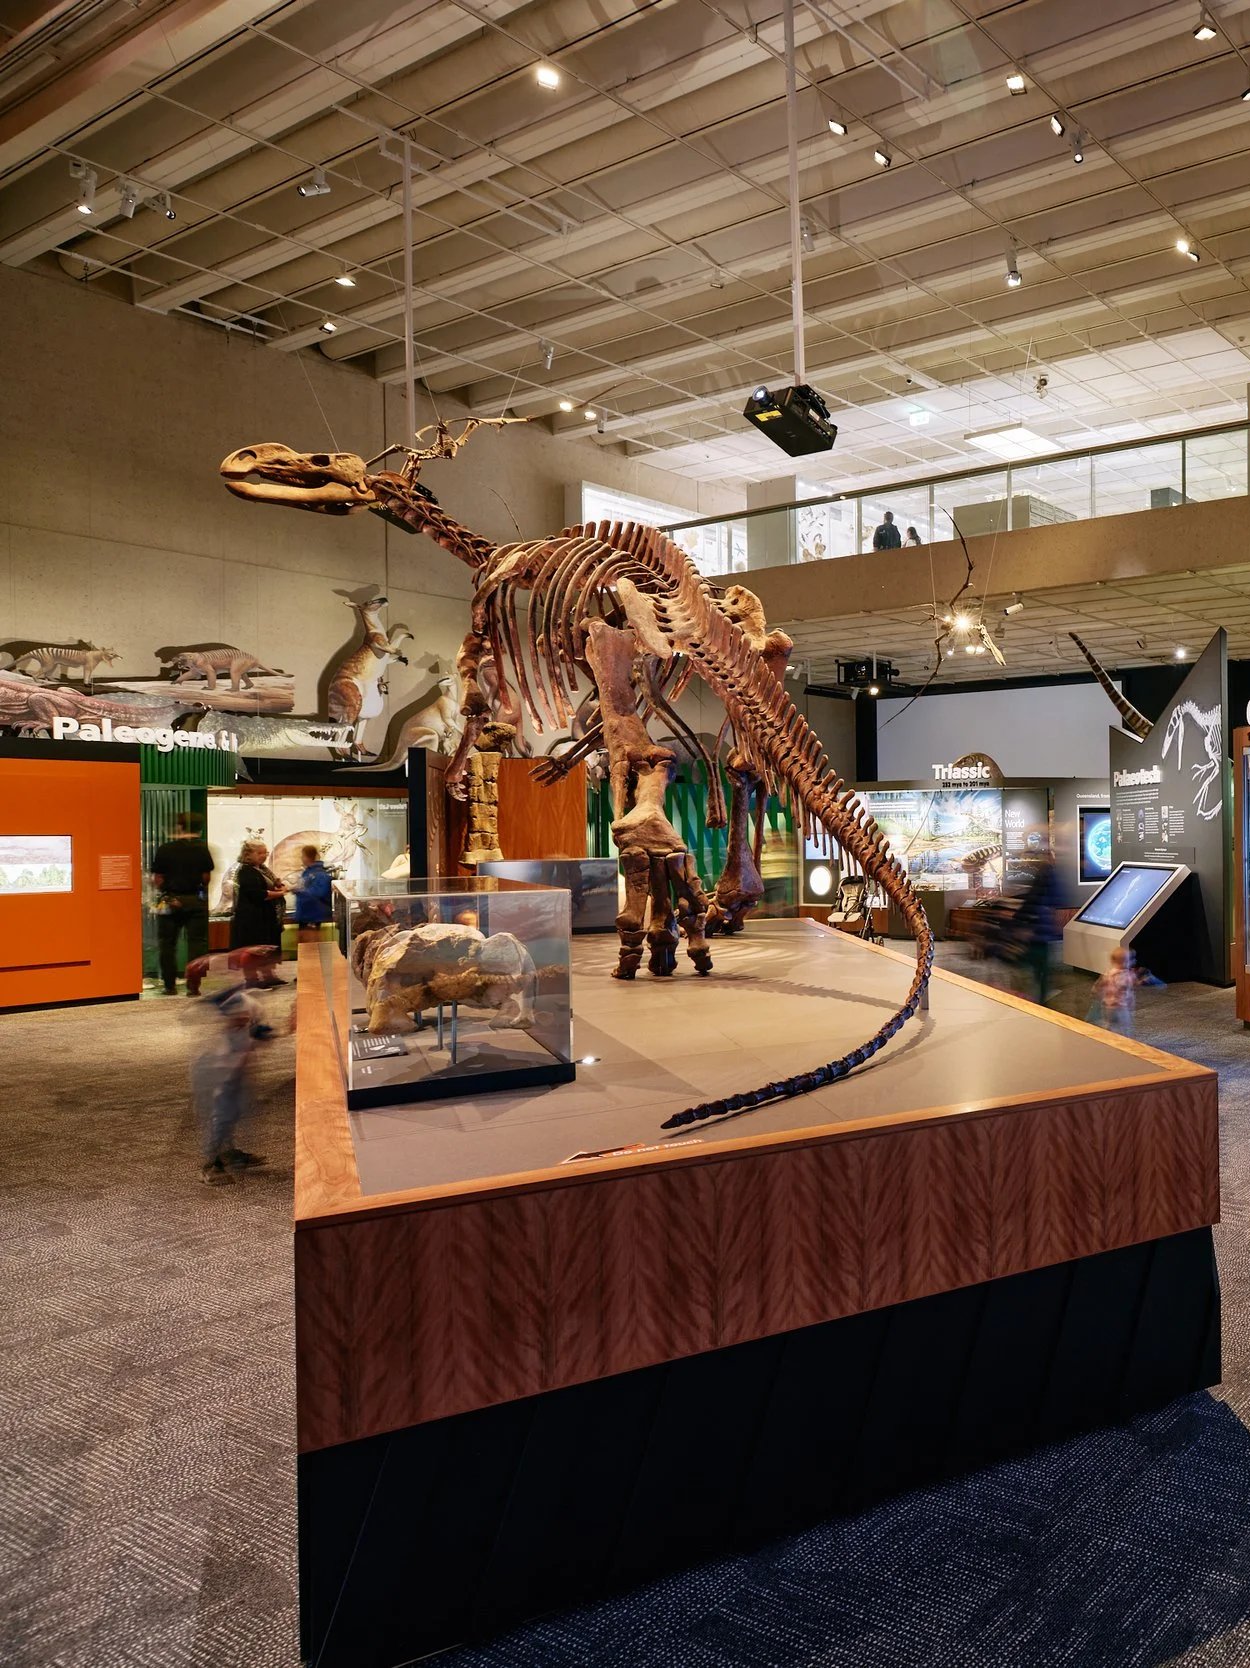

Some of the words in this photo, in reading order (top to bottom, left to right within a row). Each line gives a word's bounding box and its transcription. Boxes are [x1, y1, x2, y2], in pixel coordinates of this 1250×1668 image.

[52, 716, 217, 753] Paleogene
[932, 762, 991, 780] Triassic
[1004, 809, 1021, 818] New
[1004, 819, 1025, 828] World
[637, 1145, 660, 1153] not
[664, 1139, 703, 1149] touch
